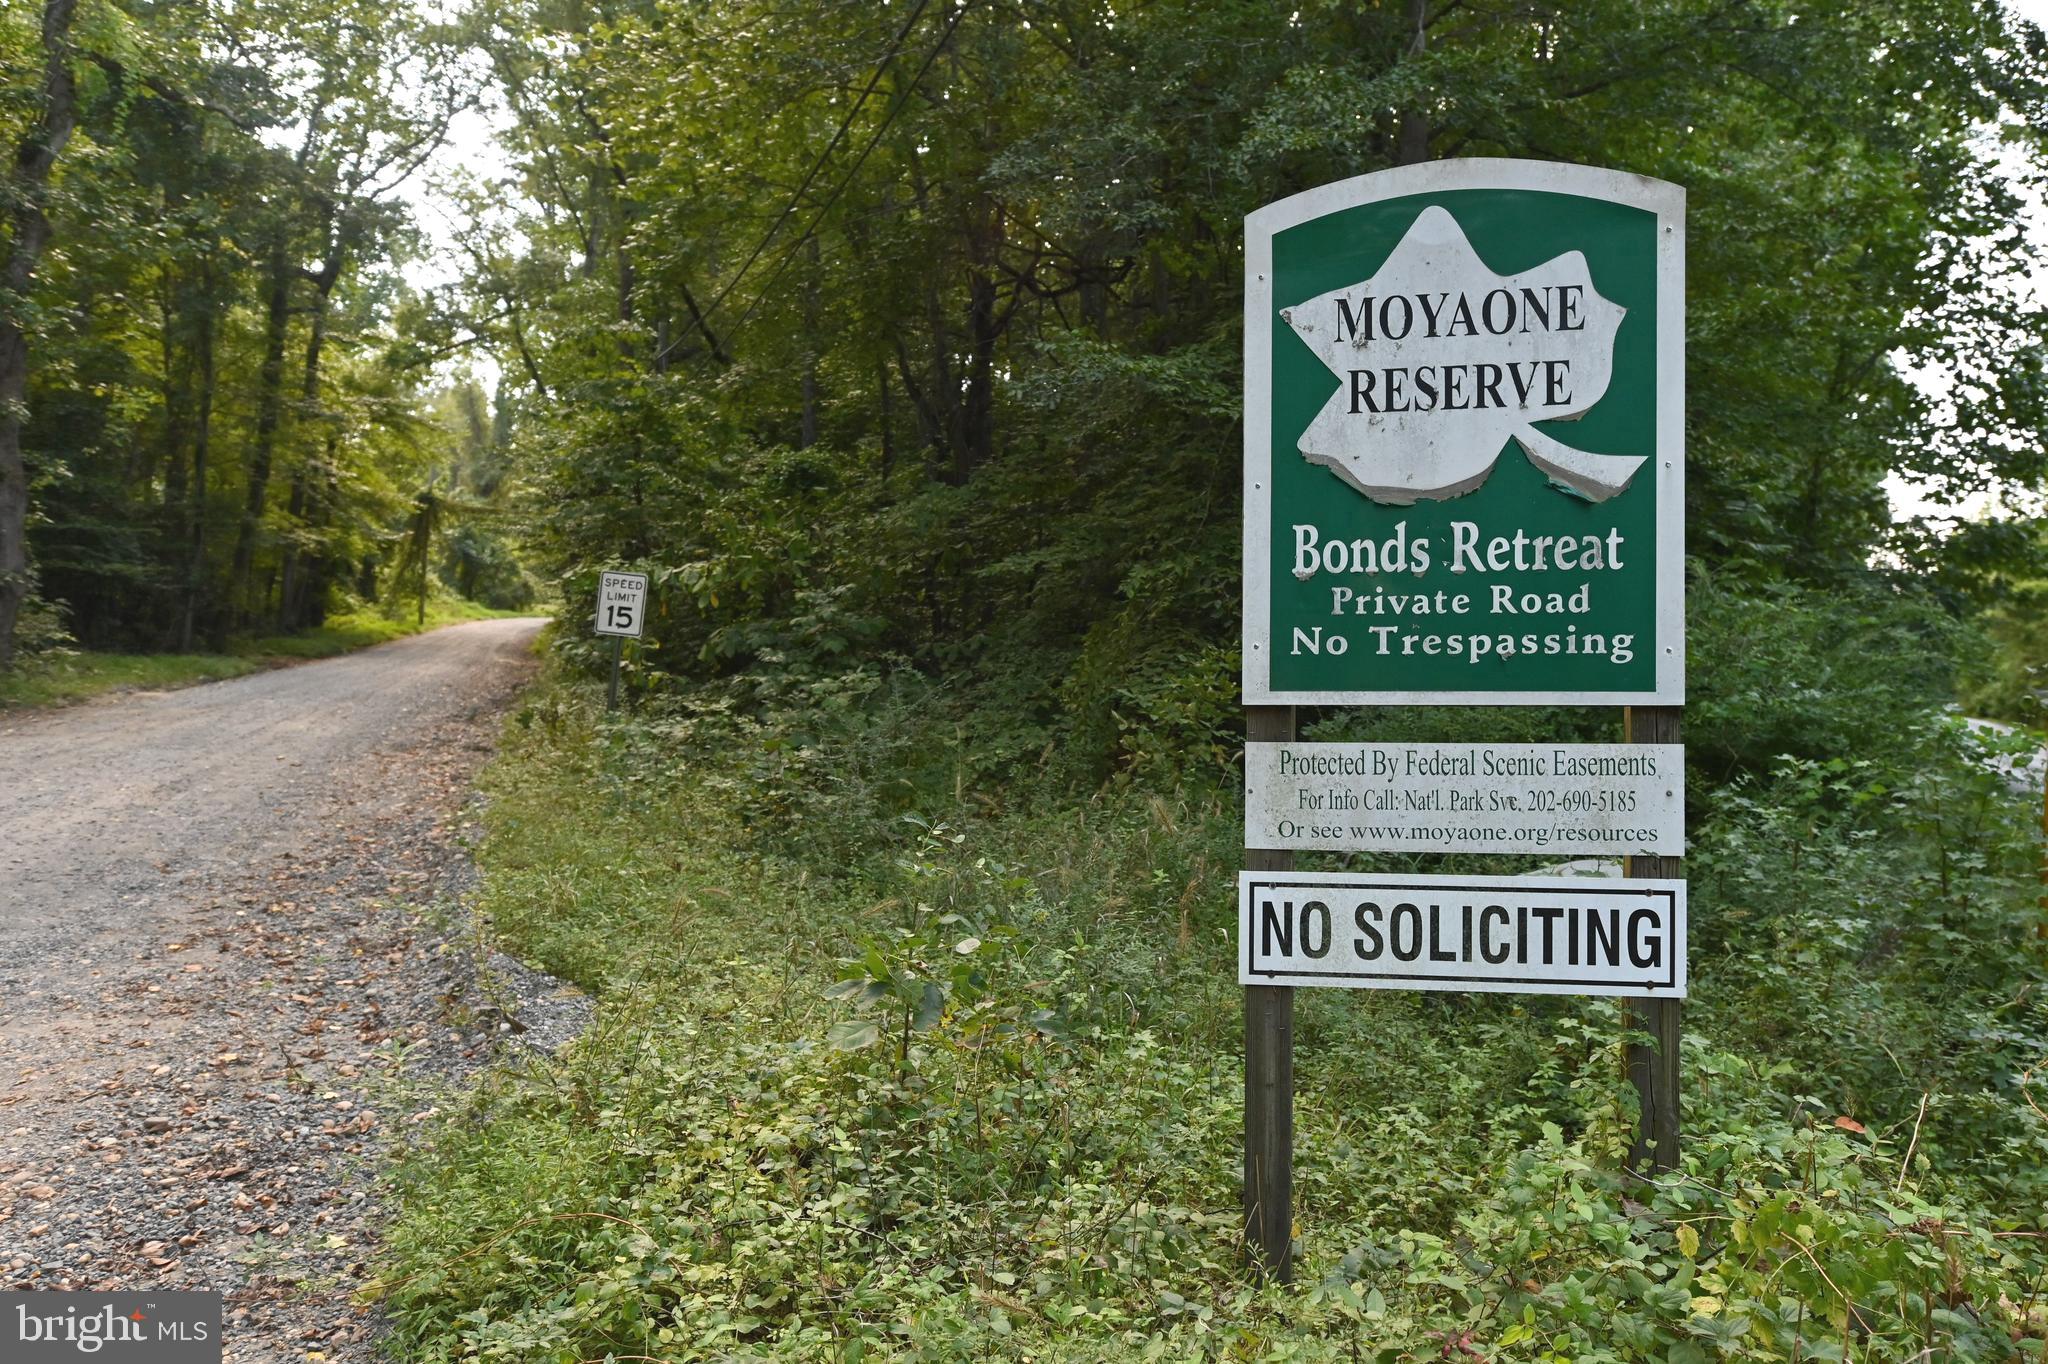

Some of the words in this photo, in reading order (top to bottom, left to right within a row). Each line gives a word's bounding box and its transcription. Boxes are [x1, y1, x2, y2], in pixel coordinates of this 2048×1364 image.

[1333, 284, 1586, 343] MOYAONE
[1347, 360, 1573, 415] RESERVE
[1292, 520, 1430, 576] Bonds
[1450, 521, 1624, 572] Retreat
[605, 578, 643, 590] SPEED
[607, 591, 637, 603] LIMIT
[1331, 586, 1471, 616] Private
[1490, 583, 1592, 615] Road
[607, 605, 633, 629] 15
[1291, 627, 1348, 656] No
[1369, 625, 1635, 663] Trespassing
[1279, 749, 1366, 776] Protected
[1372, 750, 1399, 783] By
[1405, 749, 1475, 776] Federal
[1483, 749, 1546, 776] Scenic
[1553, 750, 1657, 776] Easements
[1299, 788, 1325, 810] For
[1328, 788, 1359, 811] Info
[1364, 789, 1399, 811] Call:
[1449, 789, 1485, 811] Park
[1527, 790, 1637, 812] 202-690-5185
[1277, 820, 1305, 838] Or
[1311, 825, 1343, 839] see
[1350, 822, 1659, 846] www.moyaone.org/resources
[1260, 899, 1332, 960] NO
[1353, 901, 1662, 969] SOLICITING
